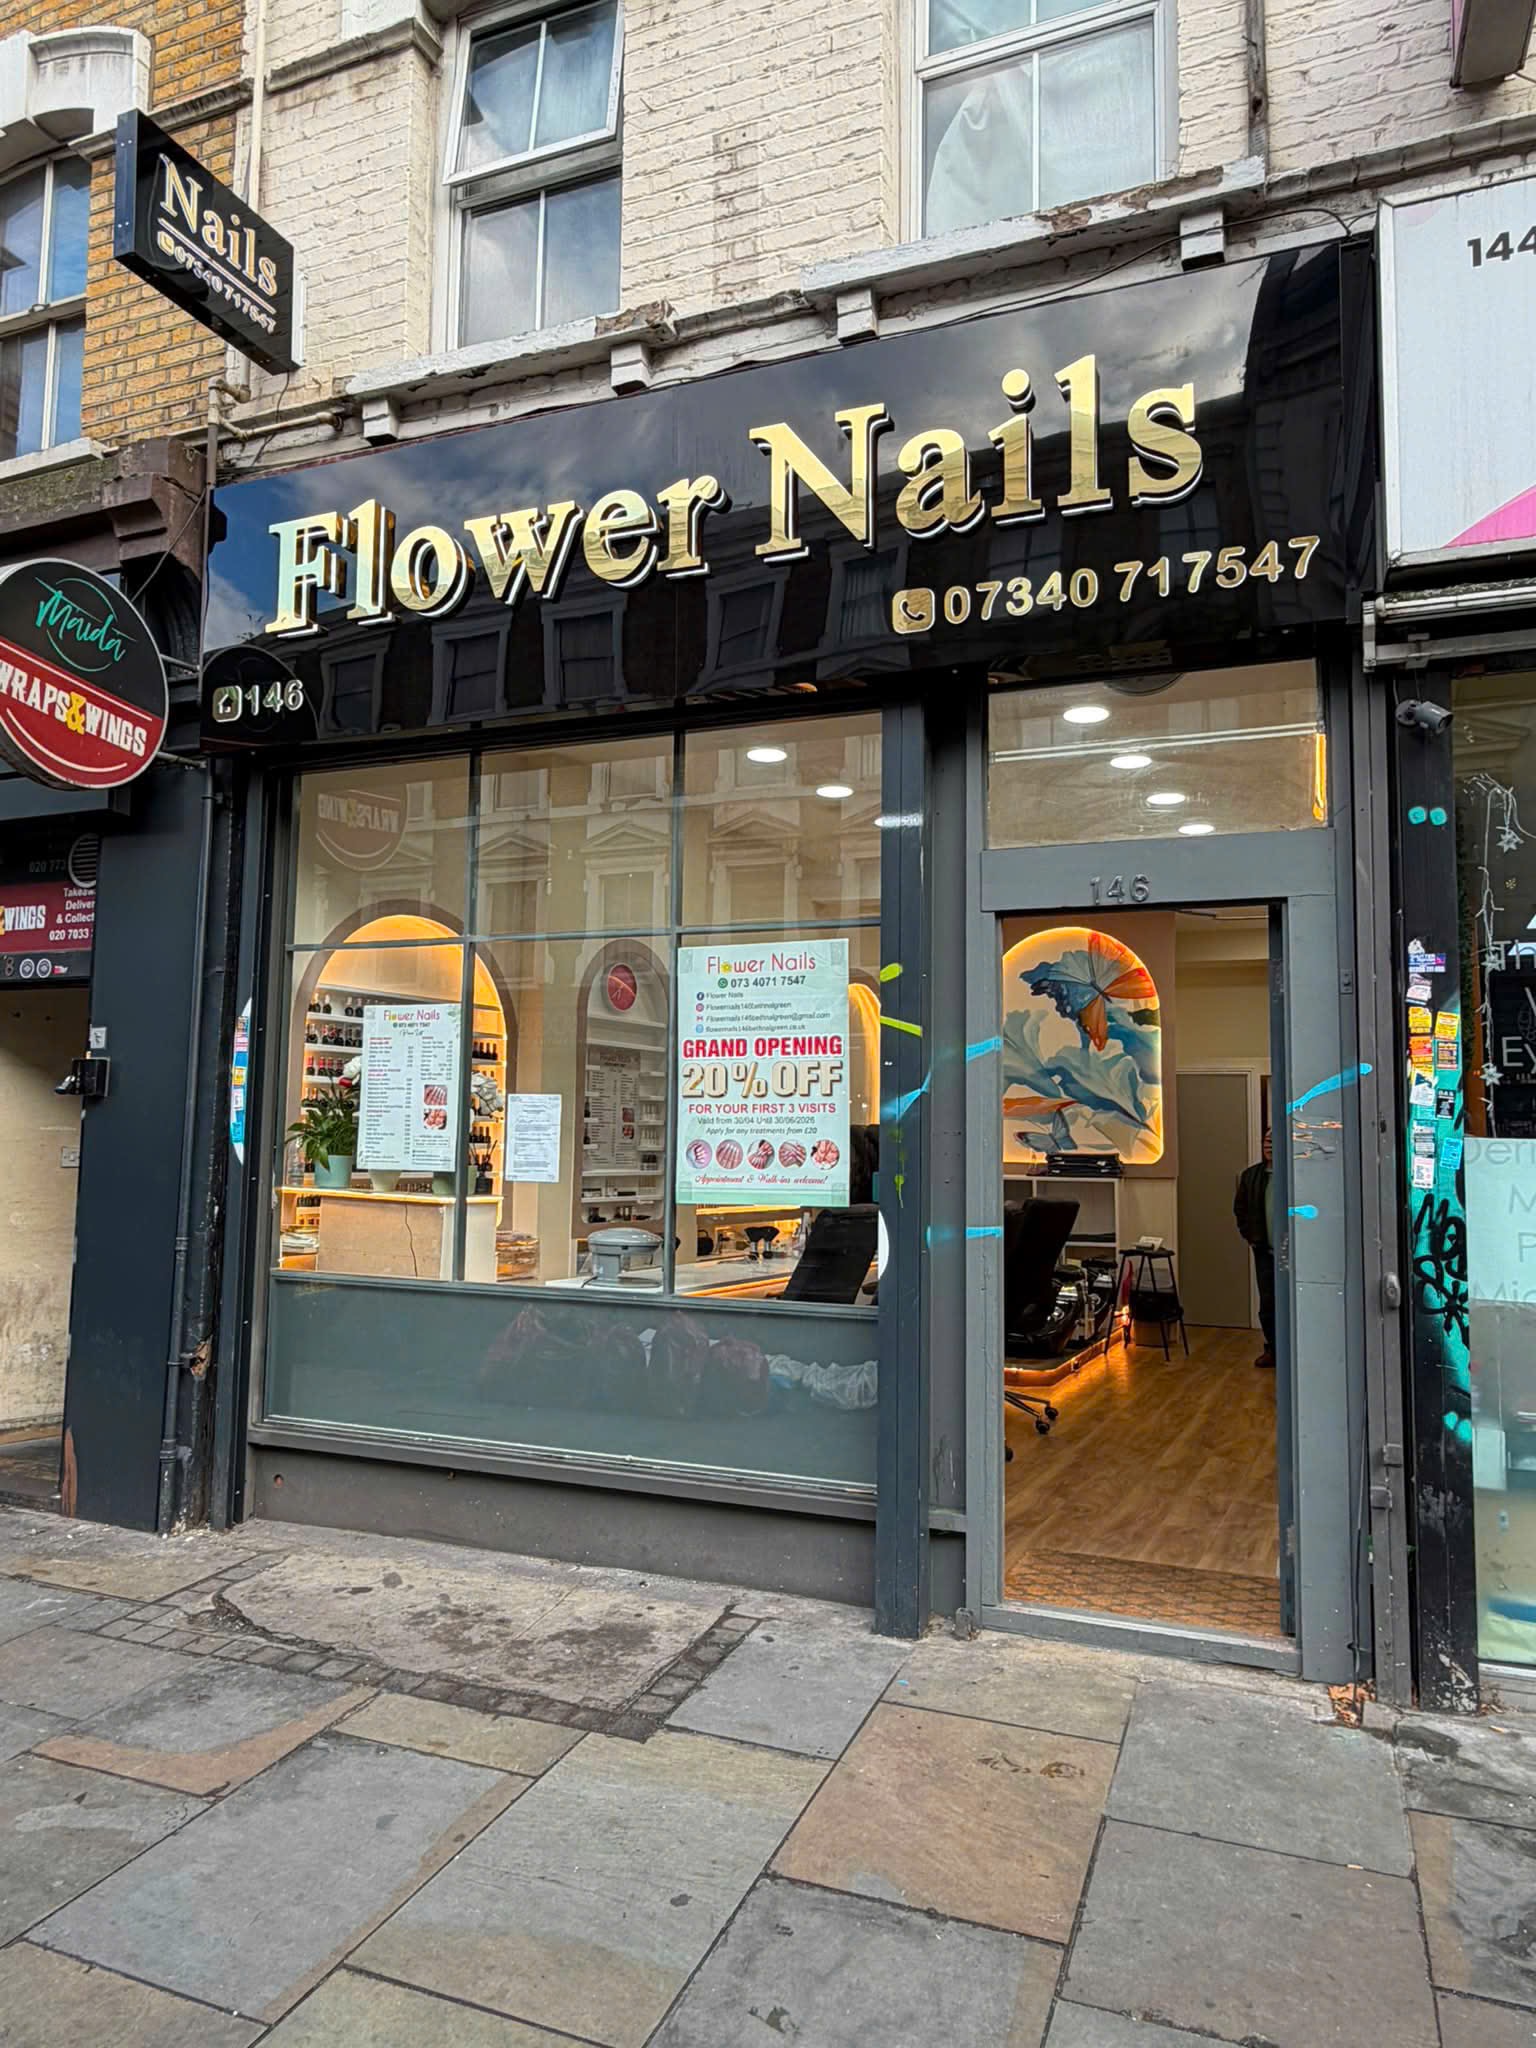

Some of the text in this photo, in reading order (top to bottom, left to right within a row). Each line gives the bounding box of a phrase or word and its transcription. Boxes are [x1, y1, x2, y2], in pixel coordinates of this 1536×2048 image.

[158, 152, 279, 298] Nails
[1467, 225, 1536, 268] 144
[265, 354, 1204, 637] Flower Nails
[943, 535, 1323, 625] 07340 717547
[35, 589, 126, 662] Maida
[245, 678, 304, 716] 146
[1089, 873, 1151, 905] 146
[48, 929, 66, 941] 020
[707, 952, 817, 975] Flower Nails
[730, 975, 806, 989] 073 4071 7547
[416, 1009, 441, 1021] Nails
[682, 1035, 844, 1059] GRAND OPENING
[681, 1059, 843, 1099] 20% OFF
[688, 1102, 837, 1114] FOR YOUR FIRST 3 VISITS
[698, 1116, 715, 1125] Valid
[706, 1127, 725, 1136] Apply
